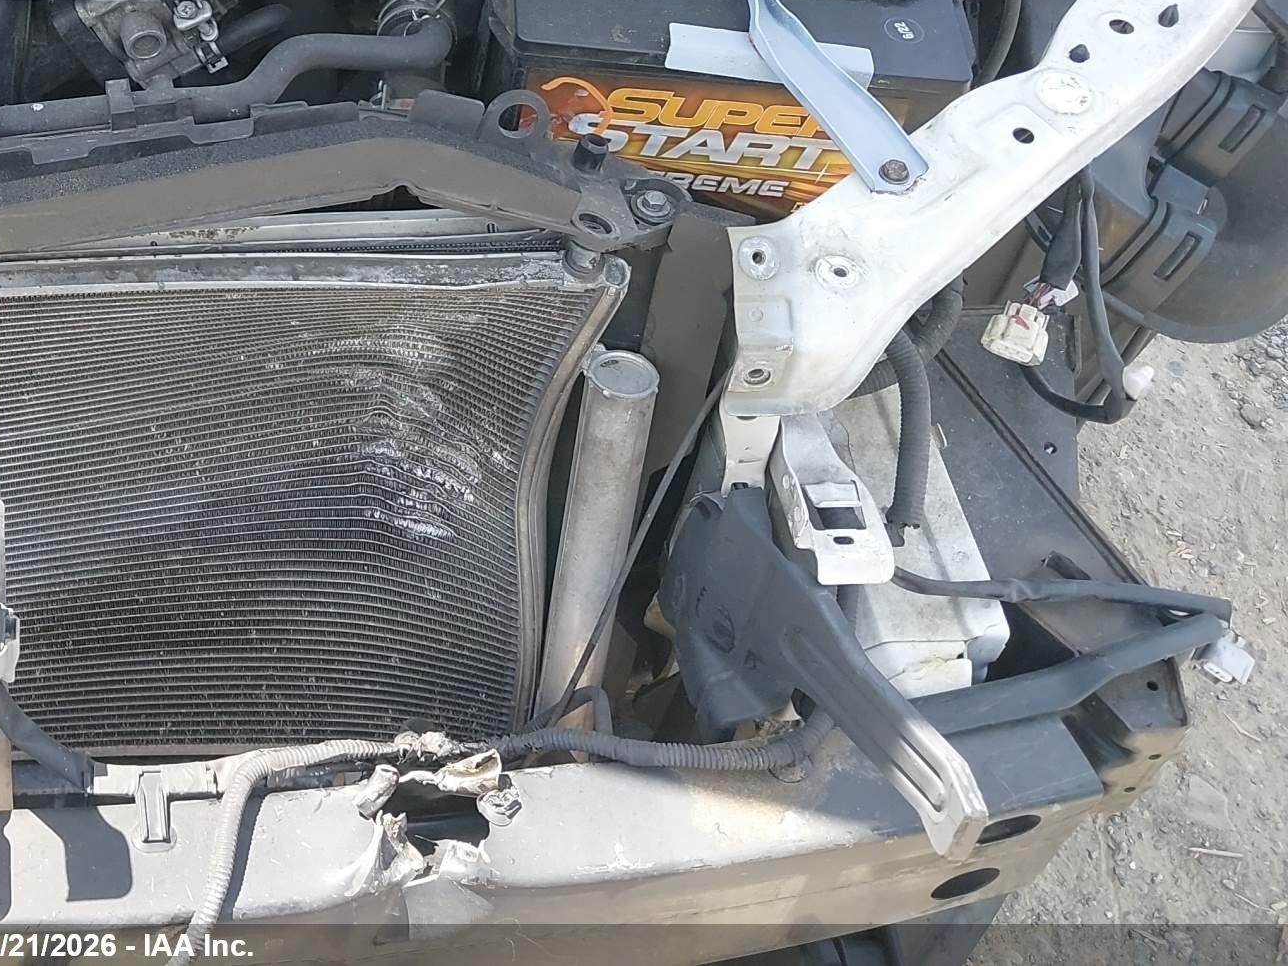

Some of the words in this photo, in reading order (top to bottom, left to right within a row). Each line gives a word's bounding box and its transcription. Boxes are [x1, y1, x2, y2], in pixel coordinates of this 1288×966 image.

[894, 21, 915, 40] 6/22
[607, 87, 825, 138] SUPE
[568, 112, 842, 171] START
[648, 170, 789, 198] REME
